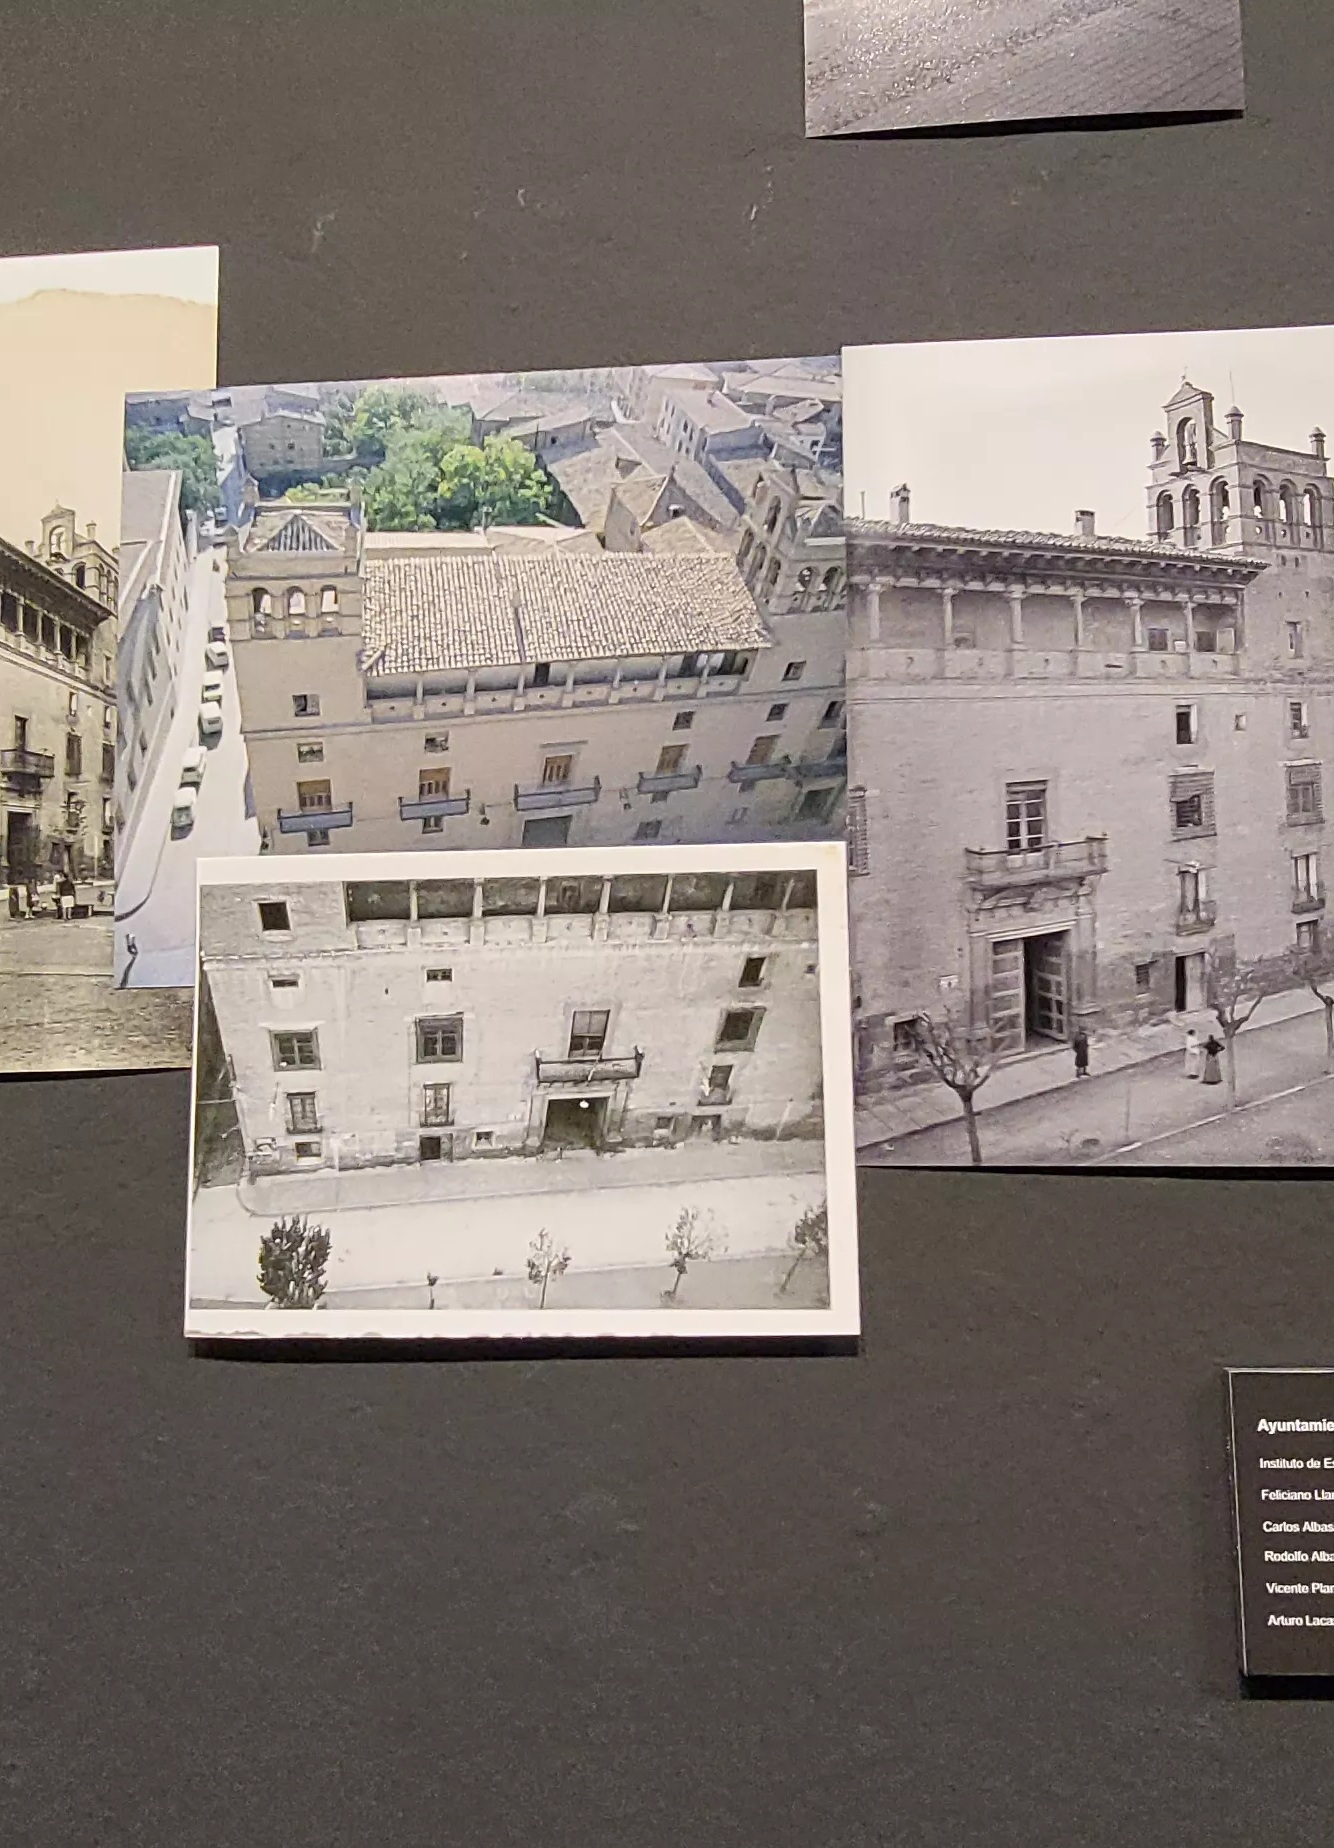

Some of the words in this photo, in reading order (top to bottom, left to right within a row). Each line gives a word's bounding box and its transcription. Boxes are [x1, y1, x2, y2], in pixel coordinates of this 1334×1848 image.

[1260, 1457, 1304, 1469] Instituto
[1306, 1458, 1321, 1468] de
[1262, 1489, 1312, 1501] Feliciano
[1263, 1521, 1300, 1533] Carlos
[1264, 1550, 1309, 1562] Rodolfo
[1266, 1582, 1309, 1594] Vicente
[1268, 1614, 1303, 1627] Arturo
